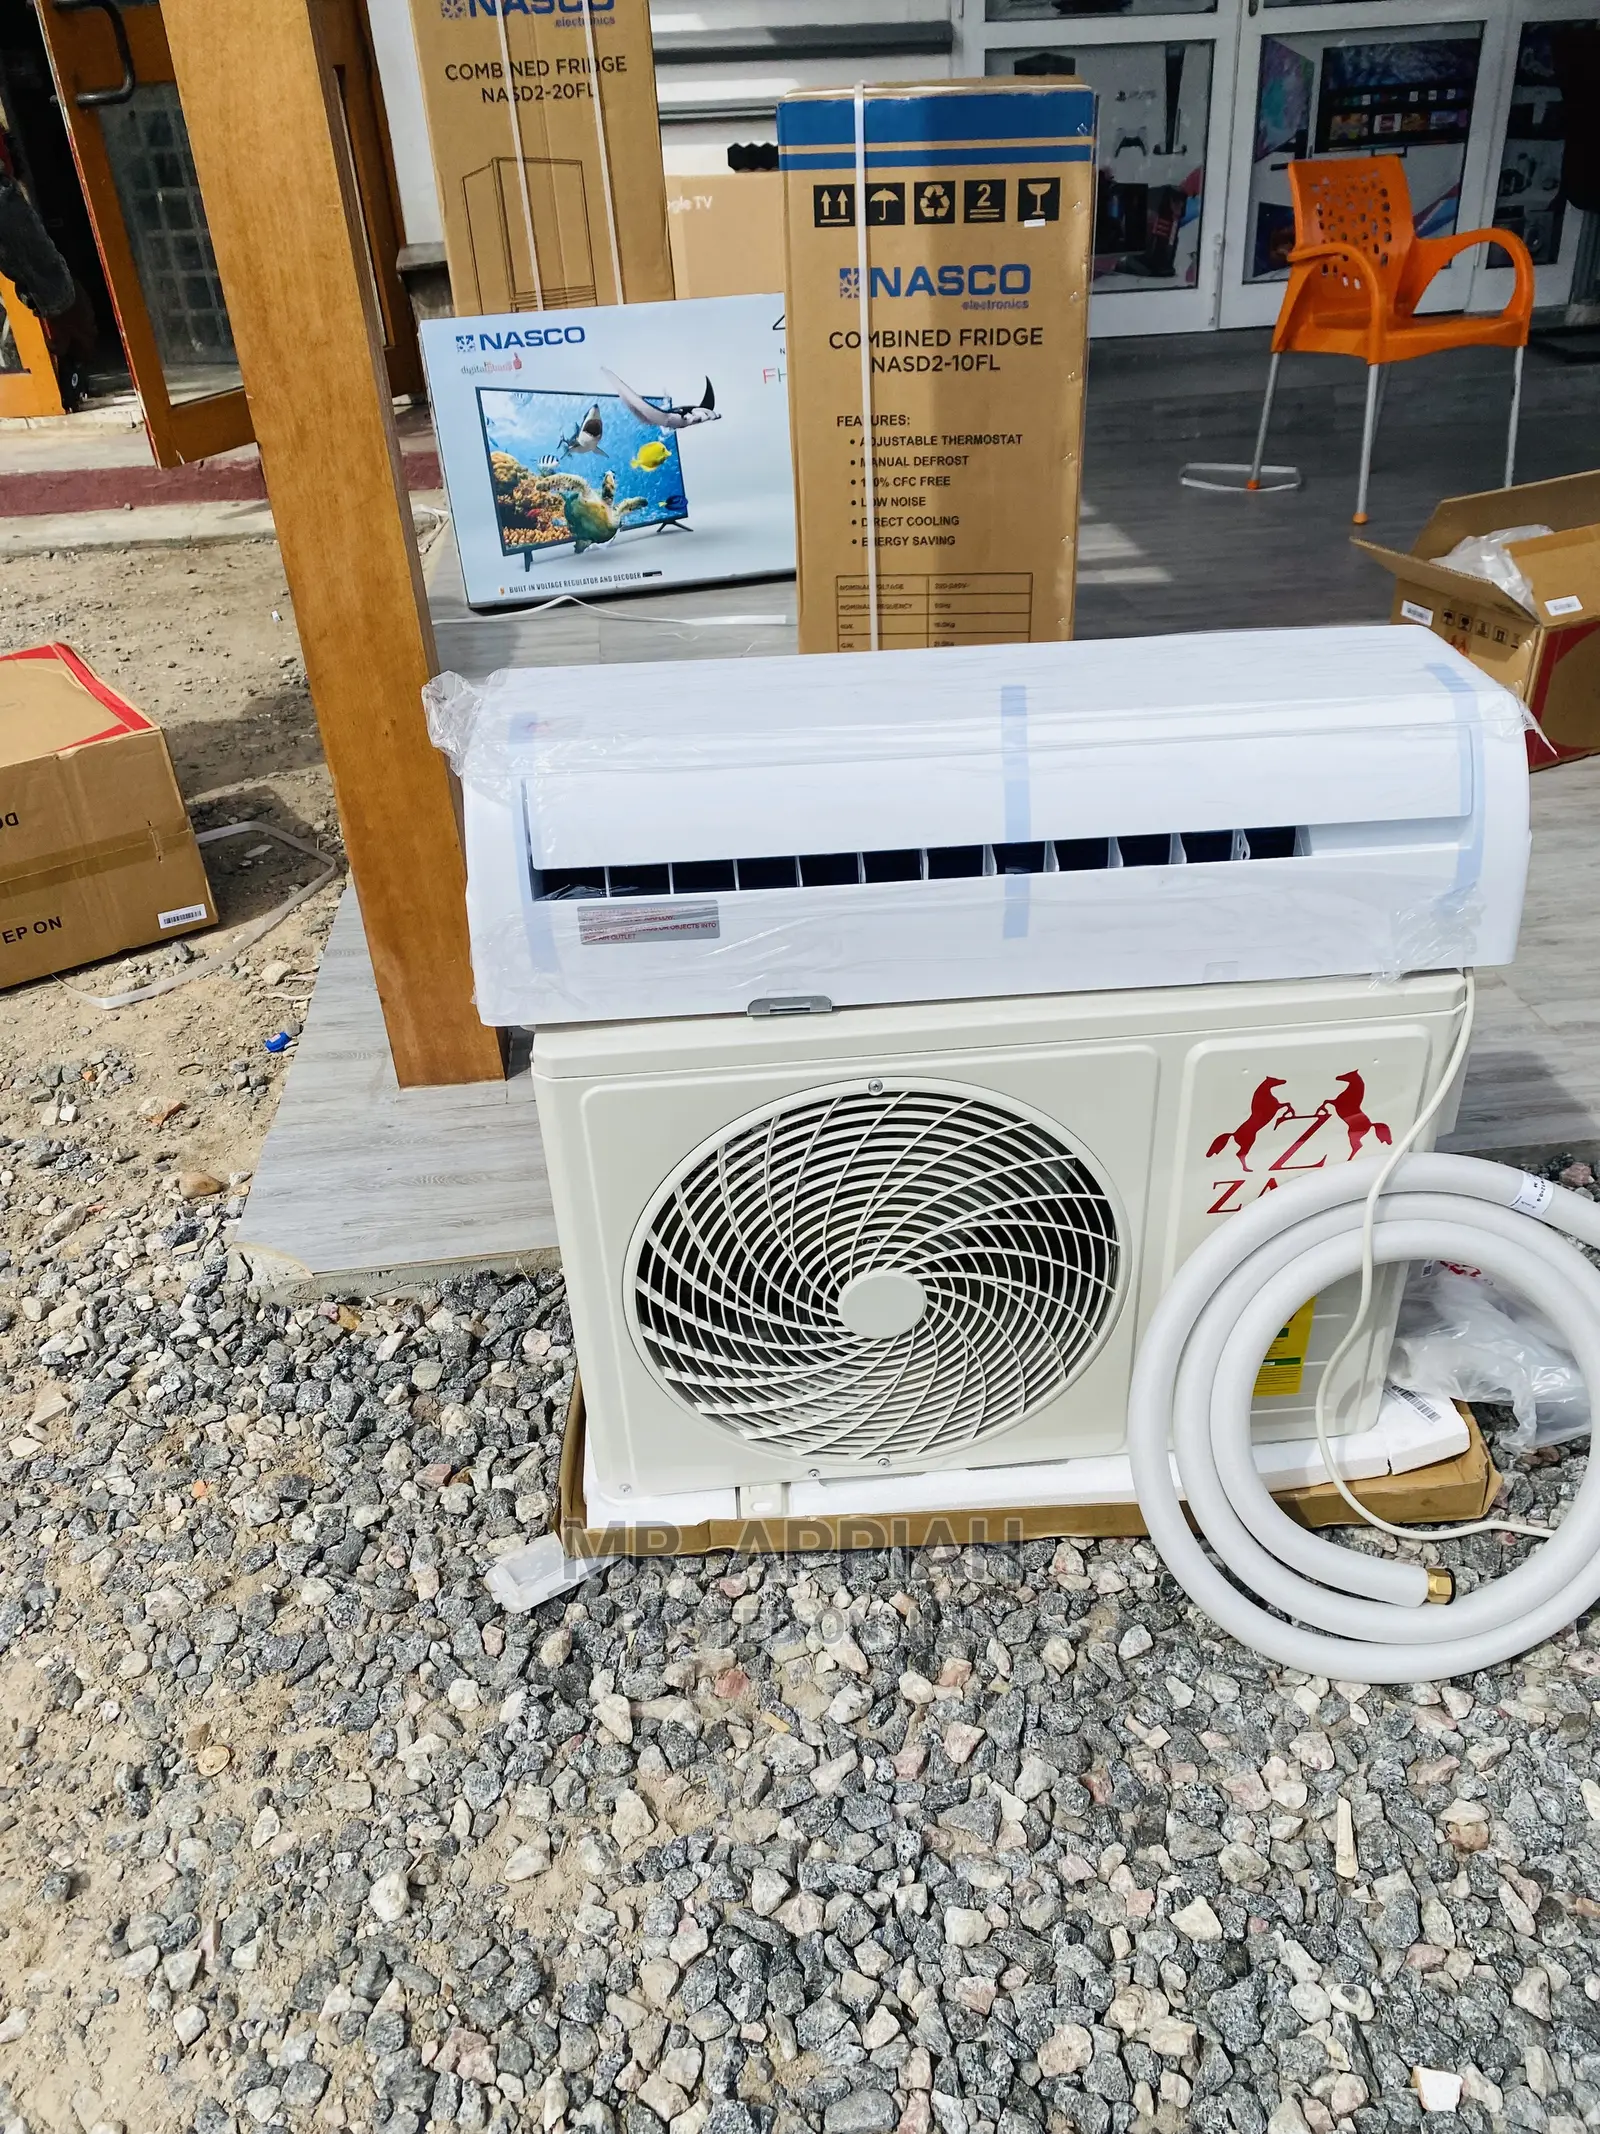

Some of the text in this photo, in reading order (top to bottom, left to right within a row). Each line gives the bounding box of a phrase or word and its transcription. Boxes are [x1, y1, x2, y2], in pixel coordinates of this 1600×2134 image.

[555, 16, 616, 28] electrnics
[445, 60, 550, 81] COMBNED
[693, 195, 713, 210] TV
[868, 263, 1031, 298] NASCO
[962, 299, 1029, 310] electronics
[479, 326, 586, 351] NASCO
[829, 327, 1044, 350] COMBINED FRIDGE
[871, 353, 1001, 374] NASD2-10FL
[836, 414, 911, 427] FEAURES:
[942, 434, 1023, 446] THERMOSTAT
[913, 455, 969, 467] DEFROST
[861, 475, 951, 488] 10% CFC FREE
[861, 496, 927, 508] LW NOISE
[861, 515, 960, 528] DRECT COOLING
[861, 535, 956, 547] EERGY SAVING
[537, 580, 563, 590] VOLTAGE
[600, 574, 613, 583] AND
[613, 571, 642, 582] DECODER
[876, 583, 904, 591] OLTAGE
[876, 603, 912, 611] REQUENCY
[33, 916, 63, 935] ON
[670, 922, 700, 931] OBJECTS
[701, 920, 717, 929] INTO
[611, 933, 636, 941] OUTLET
